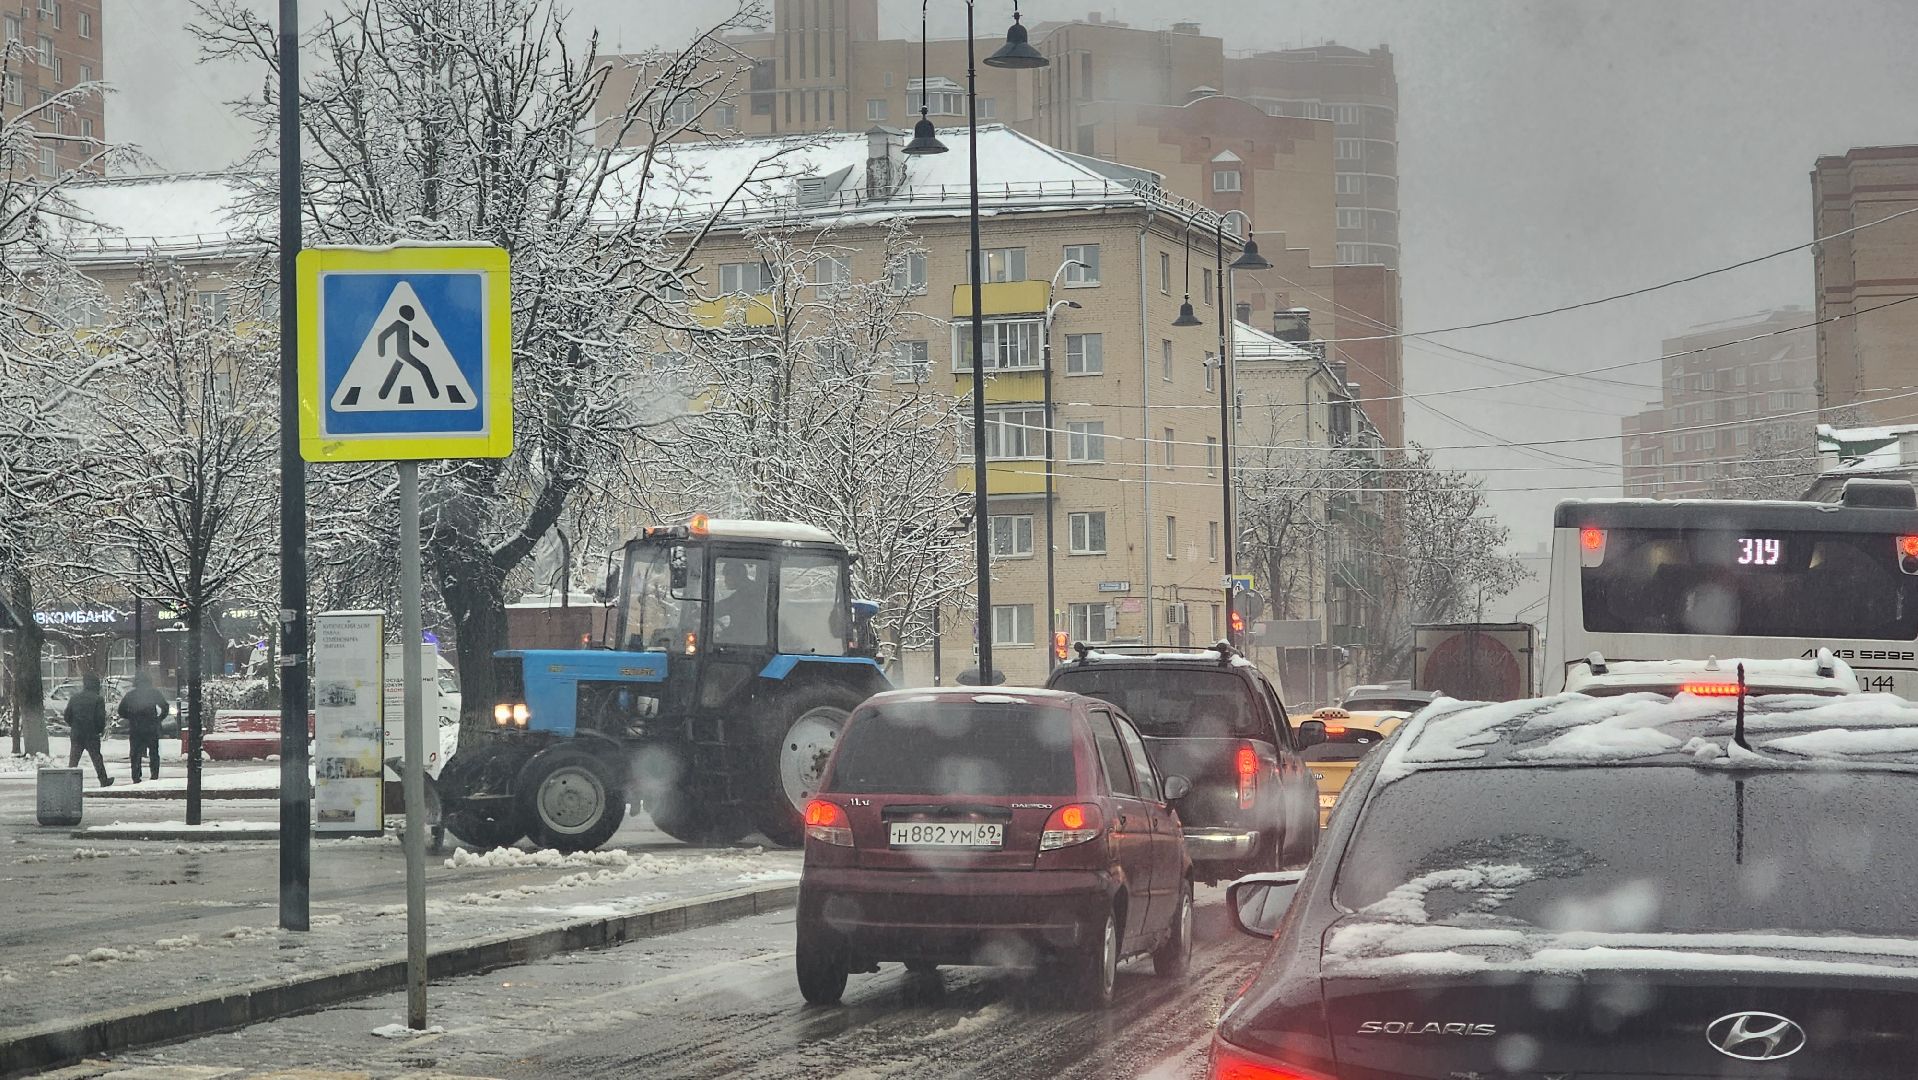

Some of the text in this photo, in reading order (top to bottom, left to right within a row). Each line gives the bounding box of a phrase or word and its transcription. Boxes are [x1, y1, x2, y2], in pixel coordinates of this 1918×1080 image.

[1738, 539, 1780, 565] 319
[33, 610, 117, 624] ВКОМБАНК
[1860, 650, 1914, 661] 5292
[1357, 1021, 1497, 1036] SOLARIS
